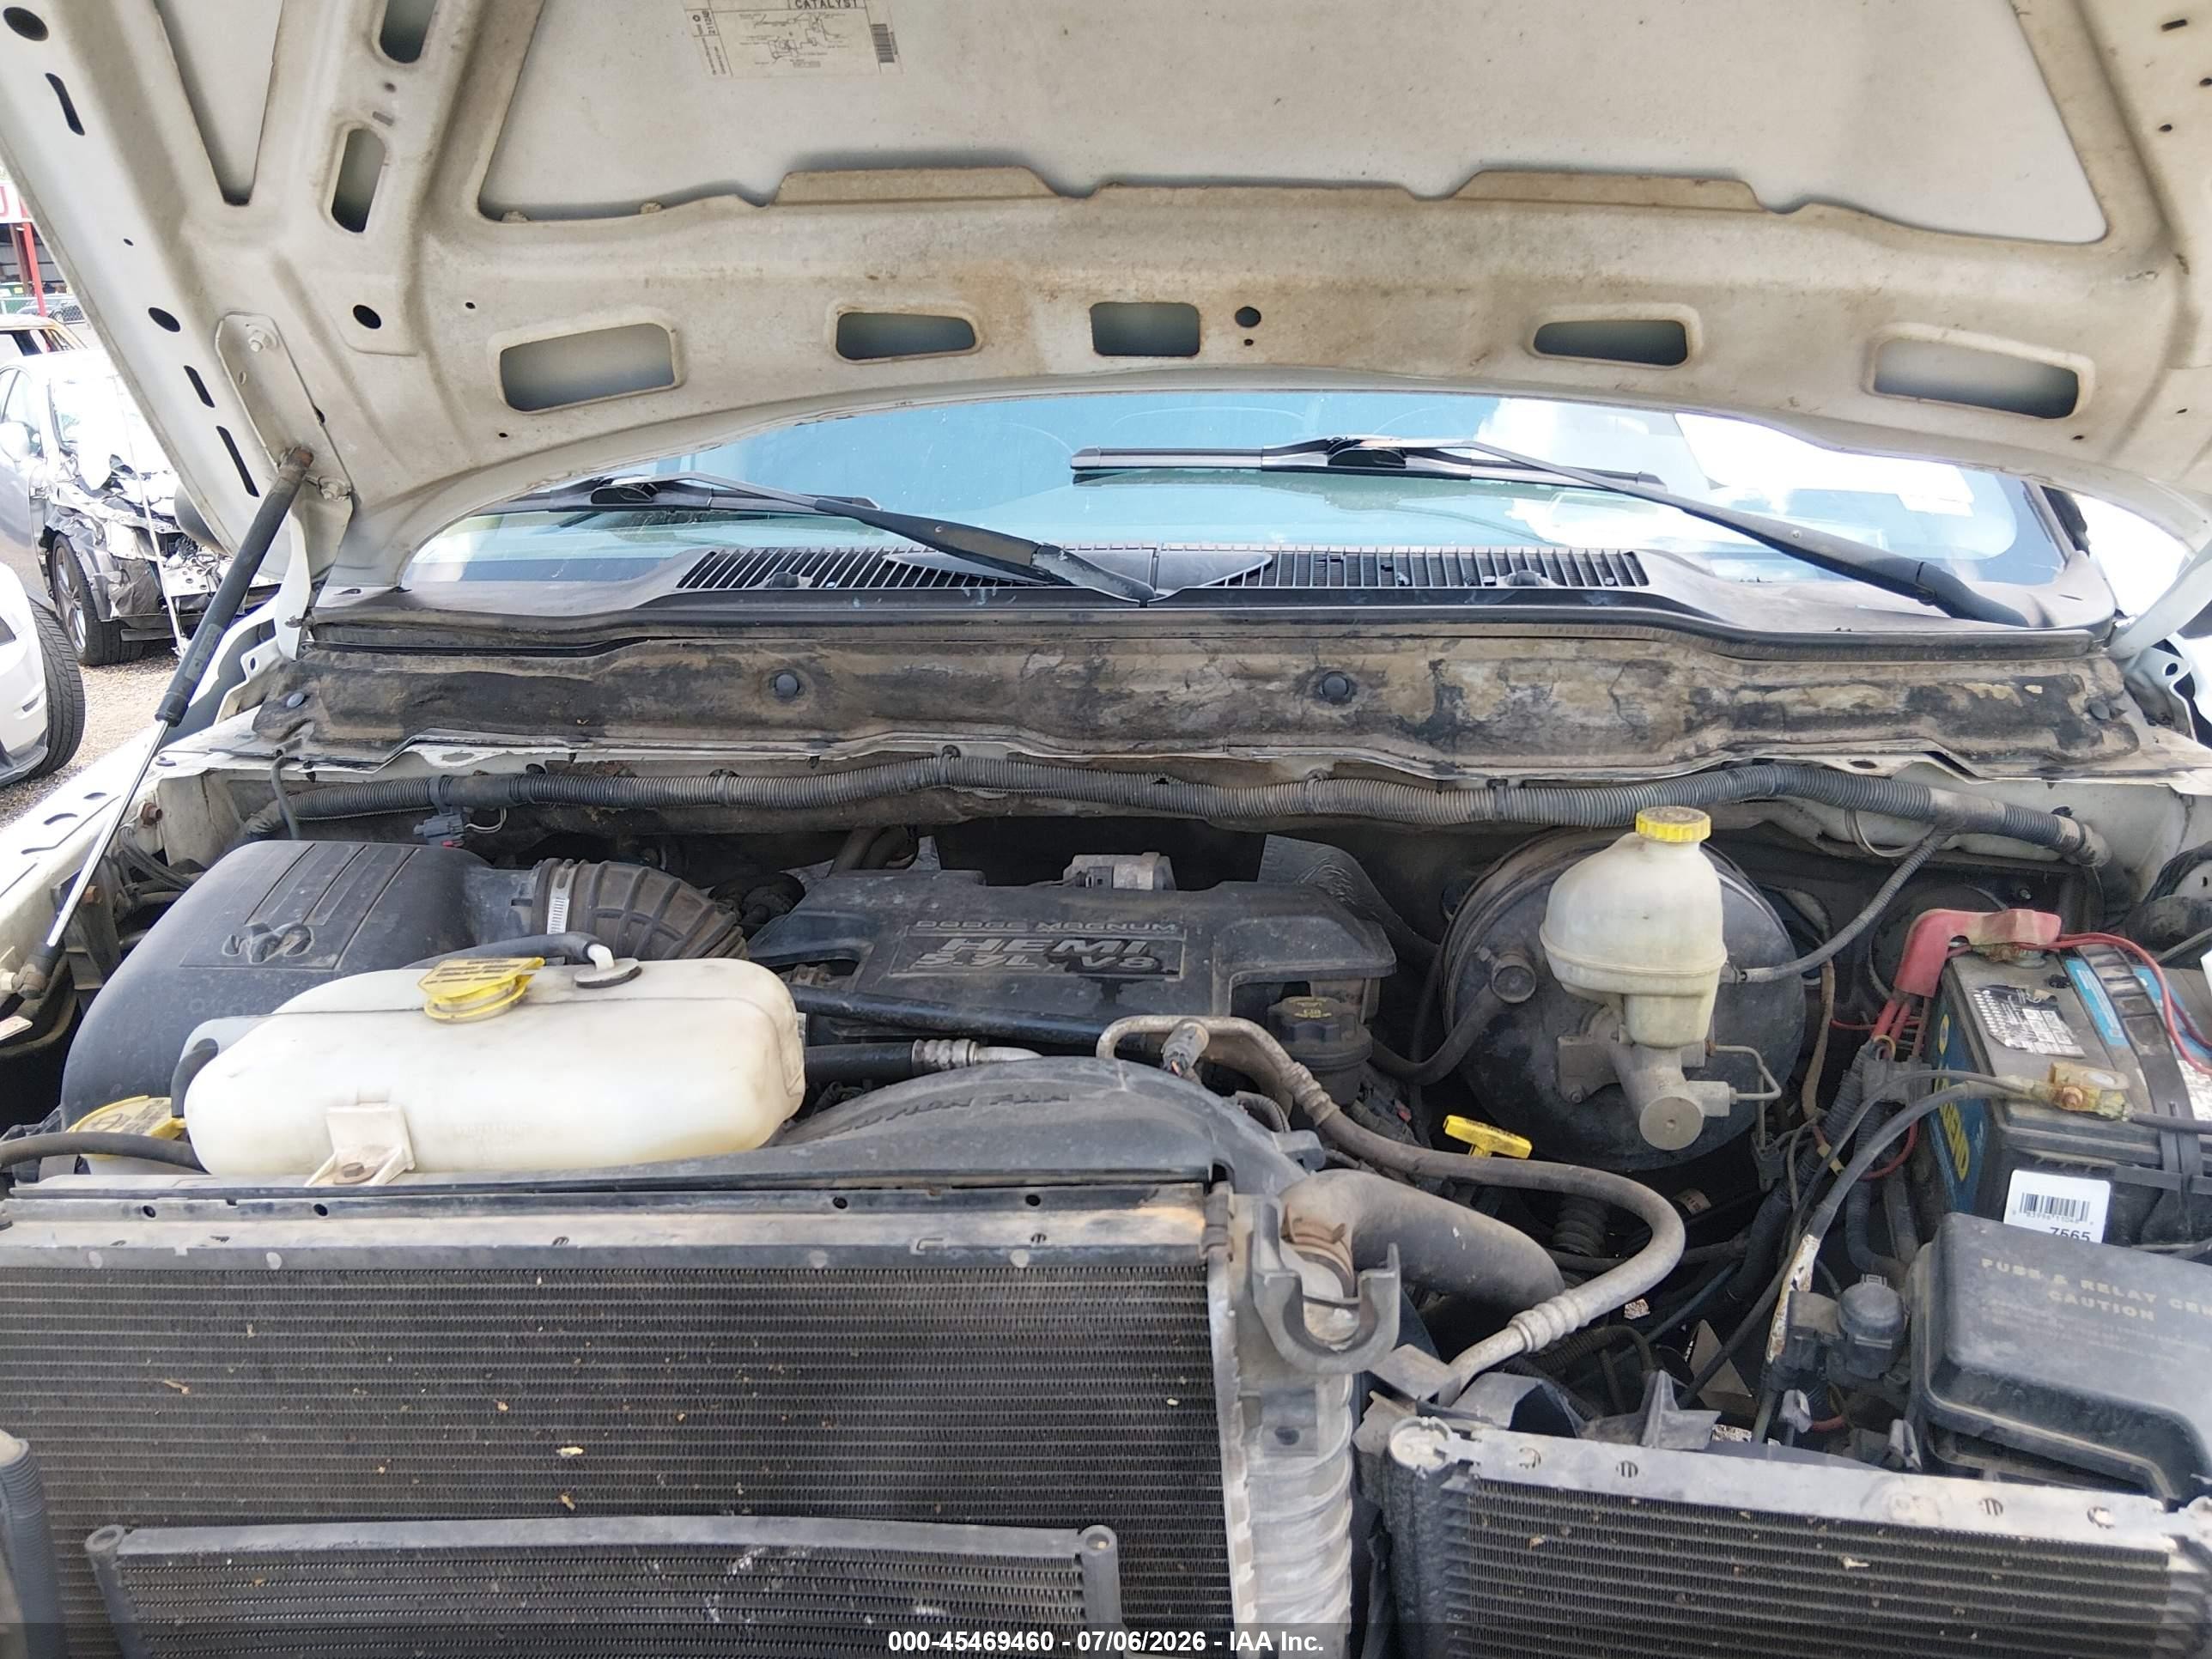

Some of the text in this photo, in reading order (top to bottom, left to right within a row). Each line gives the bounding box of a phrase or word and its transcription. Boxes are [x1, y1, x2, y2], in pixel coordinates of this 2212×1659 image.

[938, 937, 1150, 956] HEMI
[915, 953, 1158, 969] 5.7L V8
[1981, 1257, 2042, 1280] FUSE
[2081, 1279, 2158, 1304] RELAY
[2048, 1290, 2155, 1322] CAUTION
